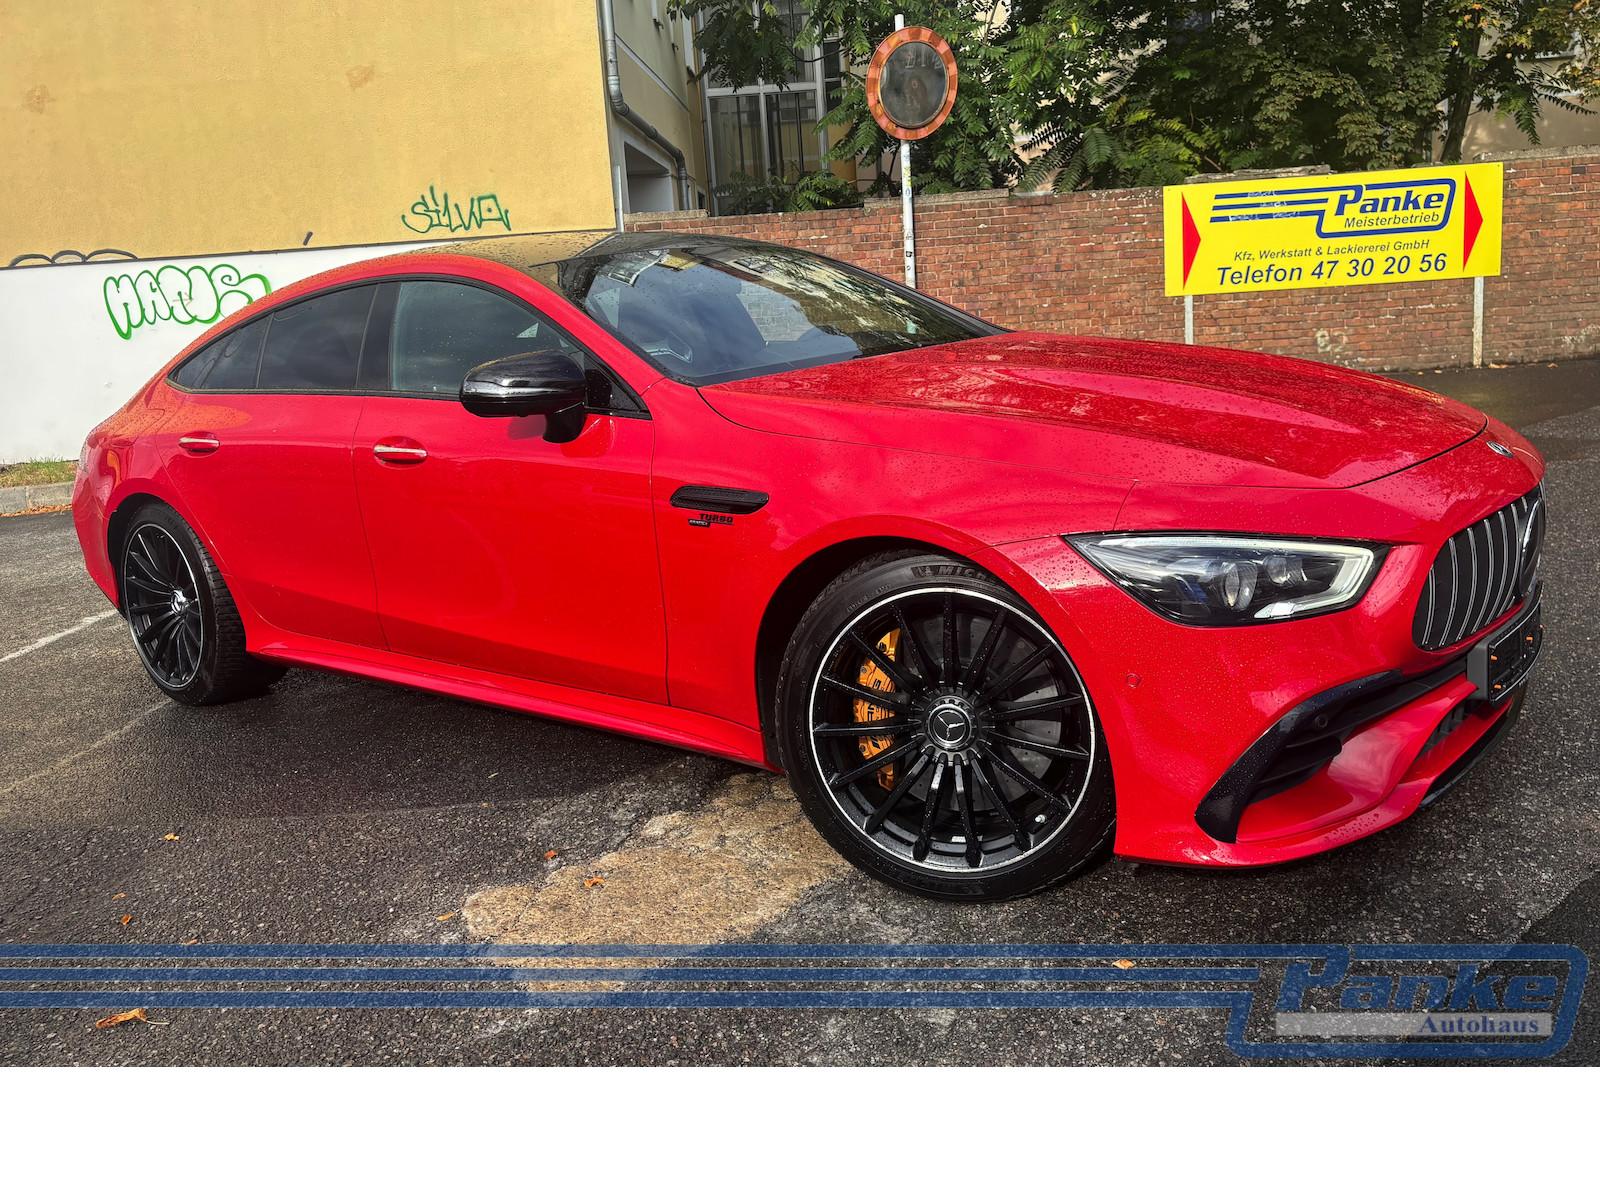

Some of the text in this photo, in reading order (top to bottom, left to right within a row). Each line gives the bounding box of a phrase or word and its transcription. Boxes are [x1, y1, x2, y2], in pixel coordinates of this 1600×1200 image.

[1335, 185, 1445, 216] Panke
[1344, 212, 1440, 229] Meisterbetrieb
[1259, 248, 1312, 259] Werkstatt
[1315, 246, 1323, 256] &
[1327, 241, 1390, 254] Lackiererei
[1393, 238, 1430, 251] GmbH
[1217, 253, 1447, 285] Telefon 47 30 20 56
